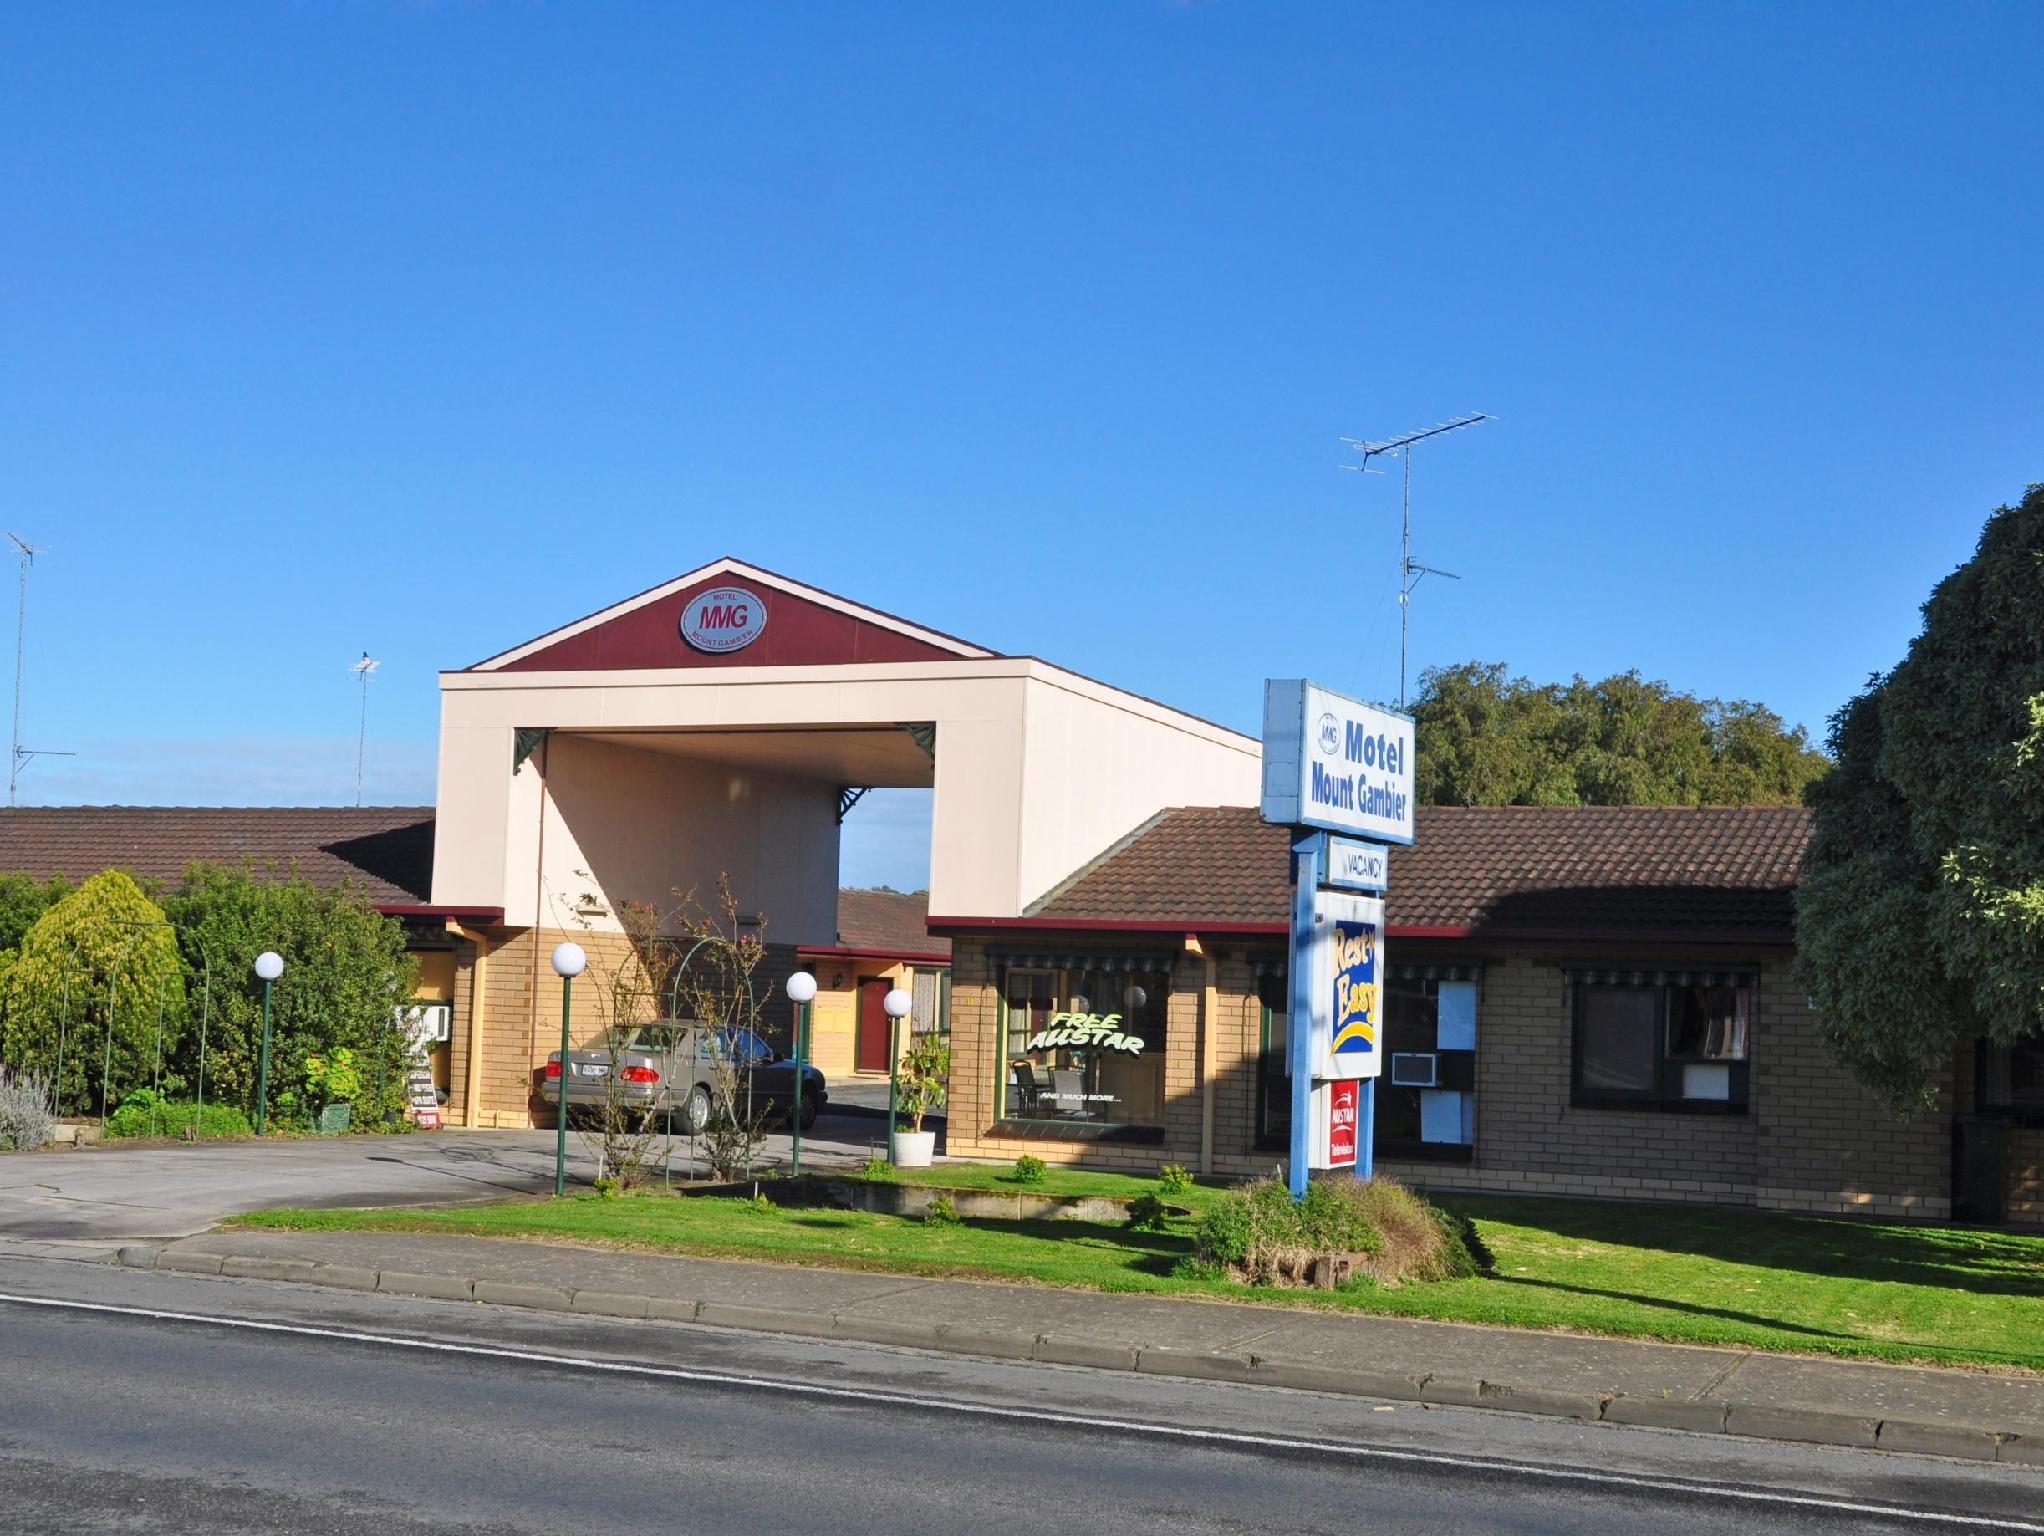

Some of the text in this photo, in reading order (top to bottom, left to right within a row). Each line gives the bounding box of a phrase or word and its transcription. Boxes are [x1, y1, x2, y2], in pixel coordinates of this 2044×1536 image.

[699, 604, 748, 629] MMG
[692, 630, 752, 647] MOUNT GAMBIER
[1322, 724, 1337, 743] MMG
[1345, 720, 1404, 775] Motel
[1312, 761, 1406, 821] Mount Gambier
[1348, 854, 1382, 878] VACANCY
[1333, 928, 1368, 977] Rest
[1337, 974, 1377, 1027] Easy
[1050, 1012, 1123, 1029] FREE
[1027, 1028, 1145, 1055] AUSTAR
